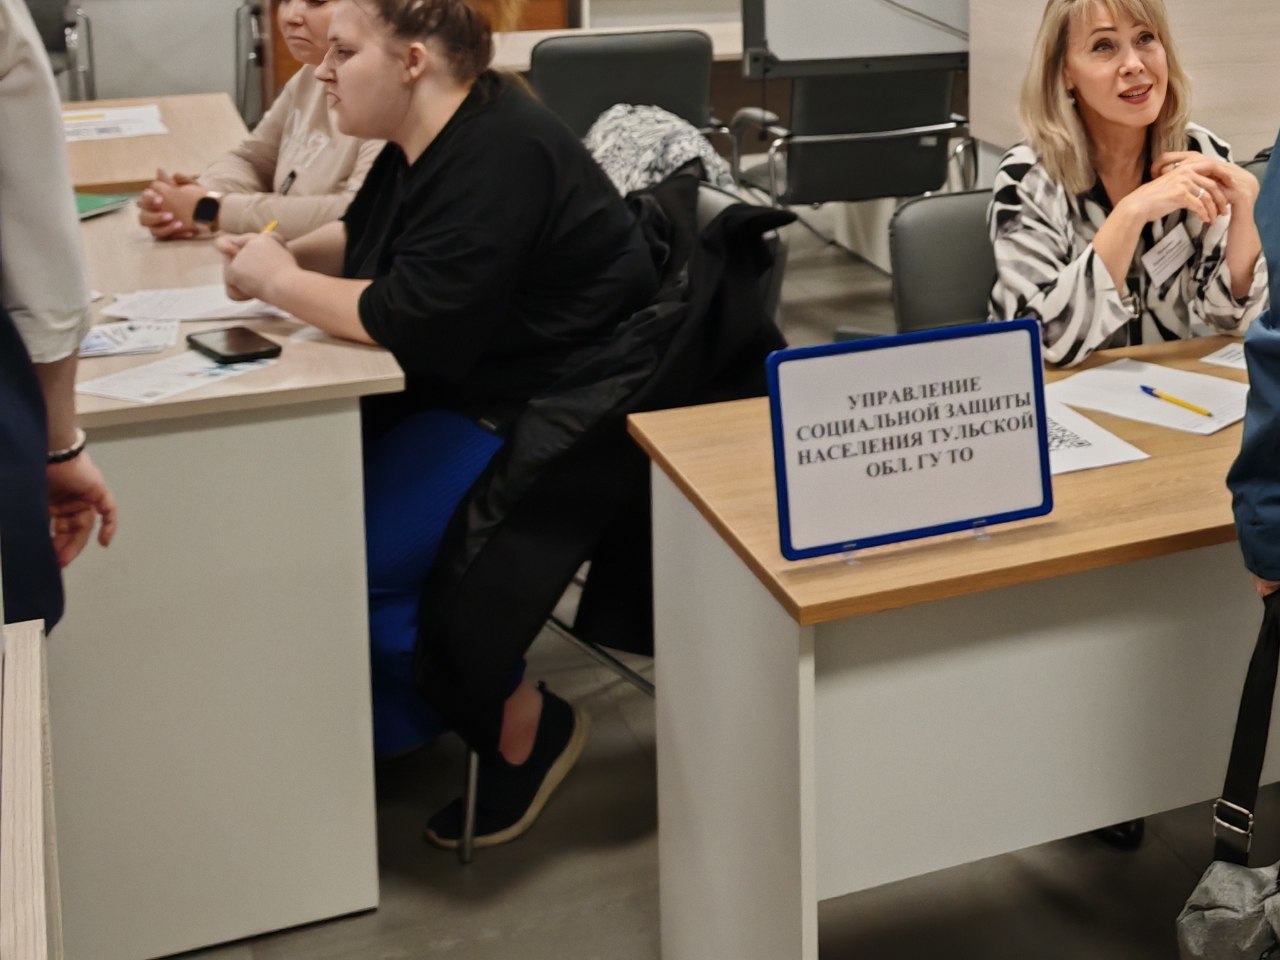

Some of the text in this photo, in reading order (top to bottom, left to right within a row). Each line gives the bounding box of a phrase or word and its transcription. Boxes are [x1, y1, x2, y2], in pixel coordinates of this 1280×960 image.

[848, 376, 982, 410] УПРАВЛЕНИЕ
[797, 392, 1031, 441] СОЦИАЛЬНОЙ ЗАЩИТЫ
[798, 410, 1034, 466] НАСЕЛЕНИЯ ТУЛЬСКОЙ
[866, 447, 974, 478] ОБЛ. ГУ ТО
